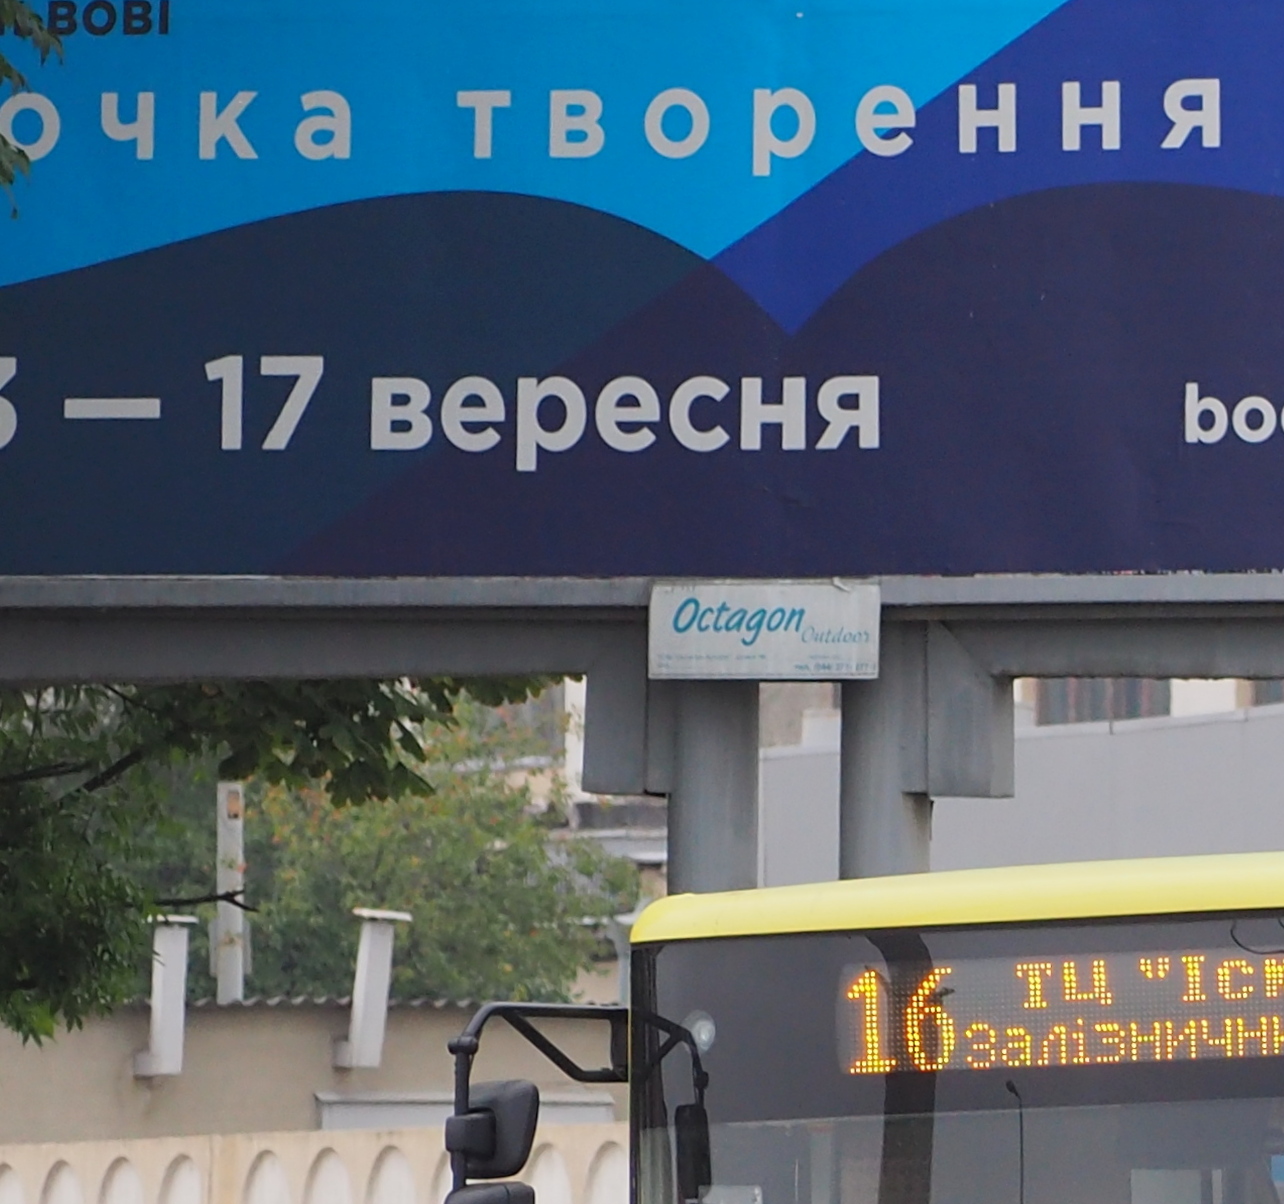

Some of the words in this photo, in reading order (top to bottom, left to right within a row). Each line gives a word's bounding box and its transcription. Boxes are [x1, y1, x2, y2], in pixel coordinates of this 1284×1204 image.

[0, 0, 170, 36] ВОВІ
[456, 78, 1222, 177] творення
[204, 355, 325, 451] 17
[370, 374, 882, 472] вересня
[672, 597, 806, 646] Octagon
[801, 625, 870, 645] Outdoor
[1016, 959, 1113, 1009] ТЦ
[848, 967, 956, 1074] 16
